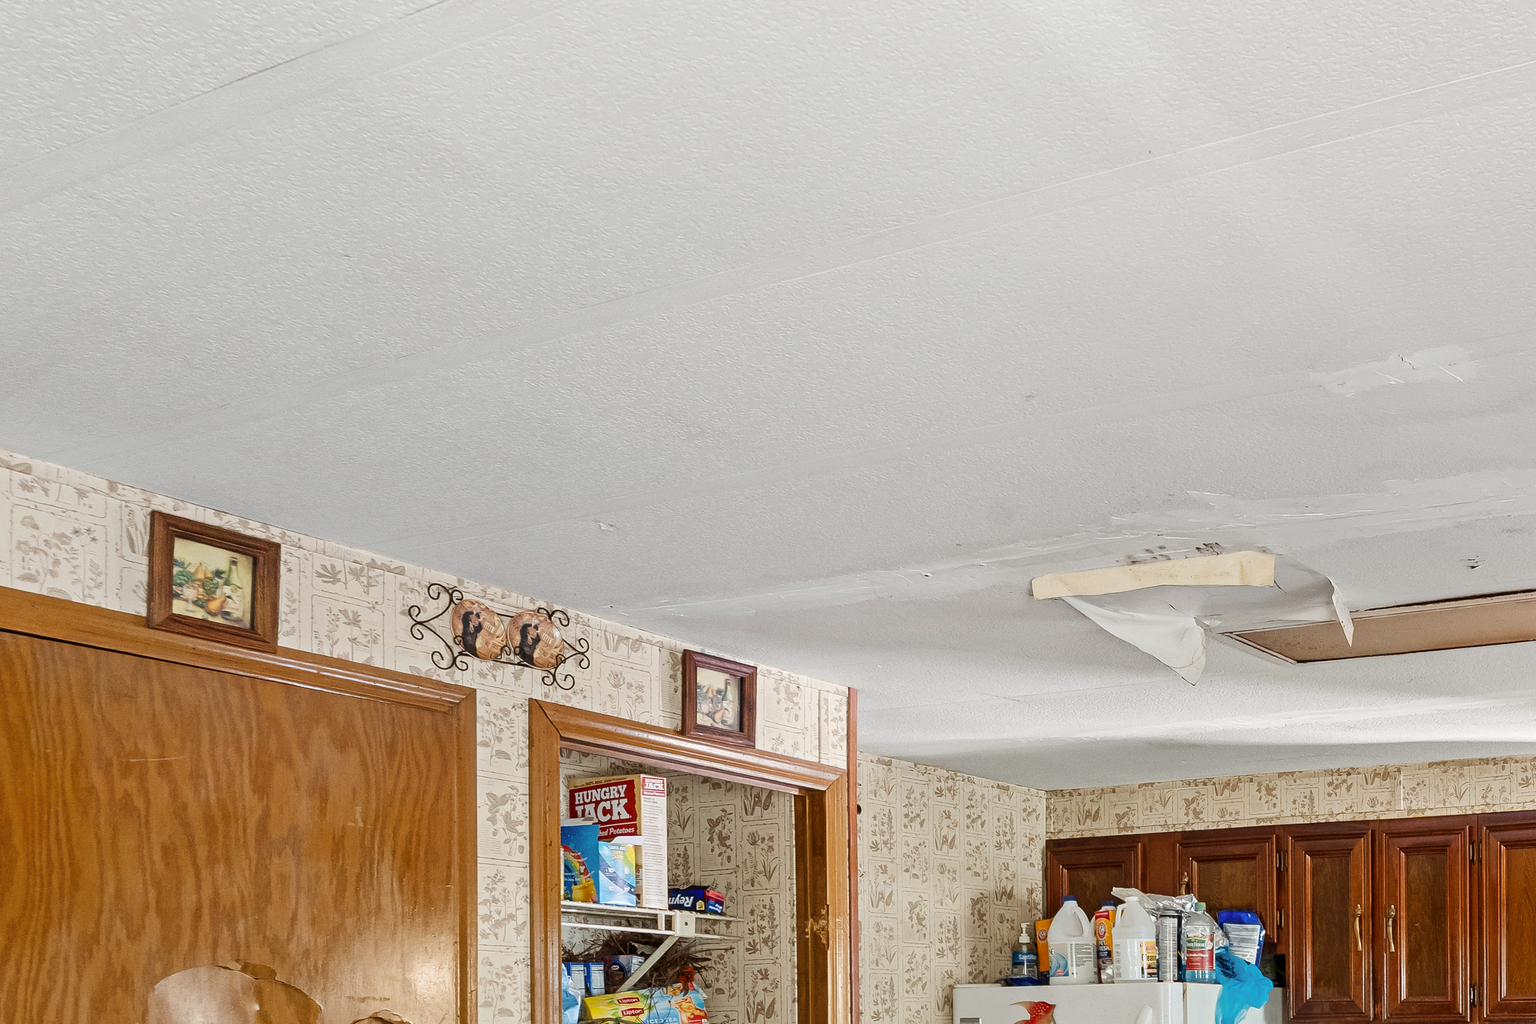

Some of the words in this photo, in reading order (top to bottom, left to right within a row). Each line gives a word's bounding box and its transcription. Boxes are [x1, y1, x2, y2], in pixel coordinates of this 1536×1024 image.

[574, 784, 627, 804] HUNGRY
[575, 798, 630, 823] JACK
[609, 826, 635, 835] Potatoes
